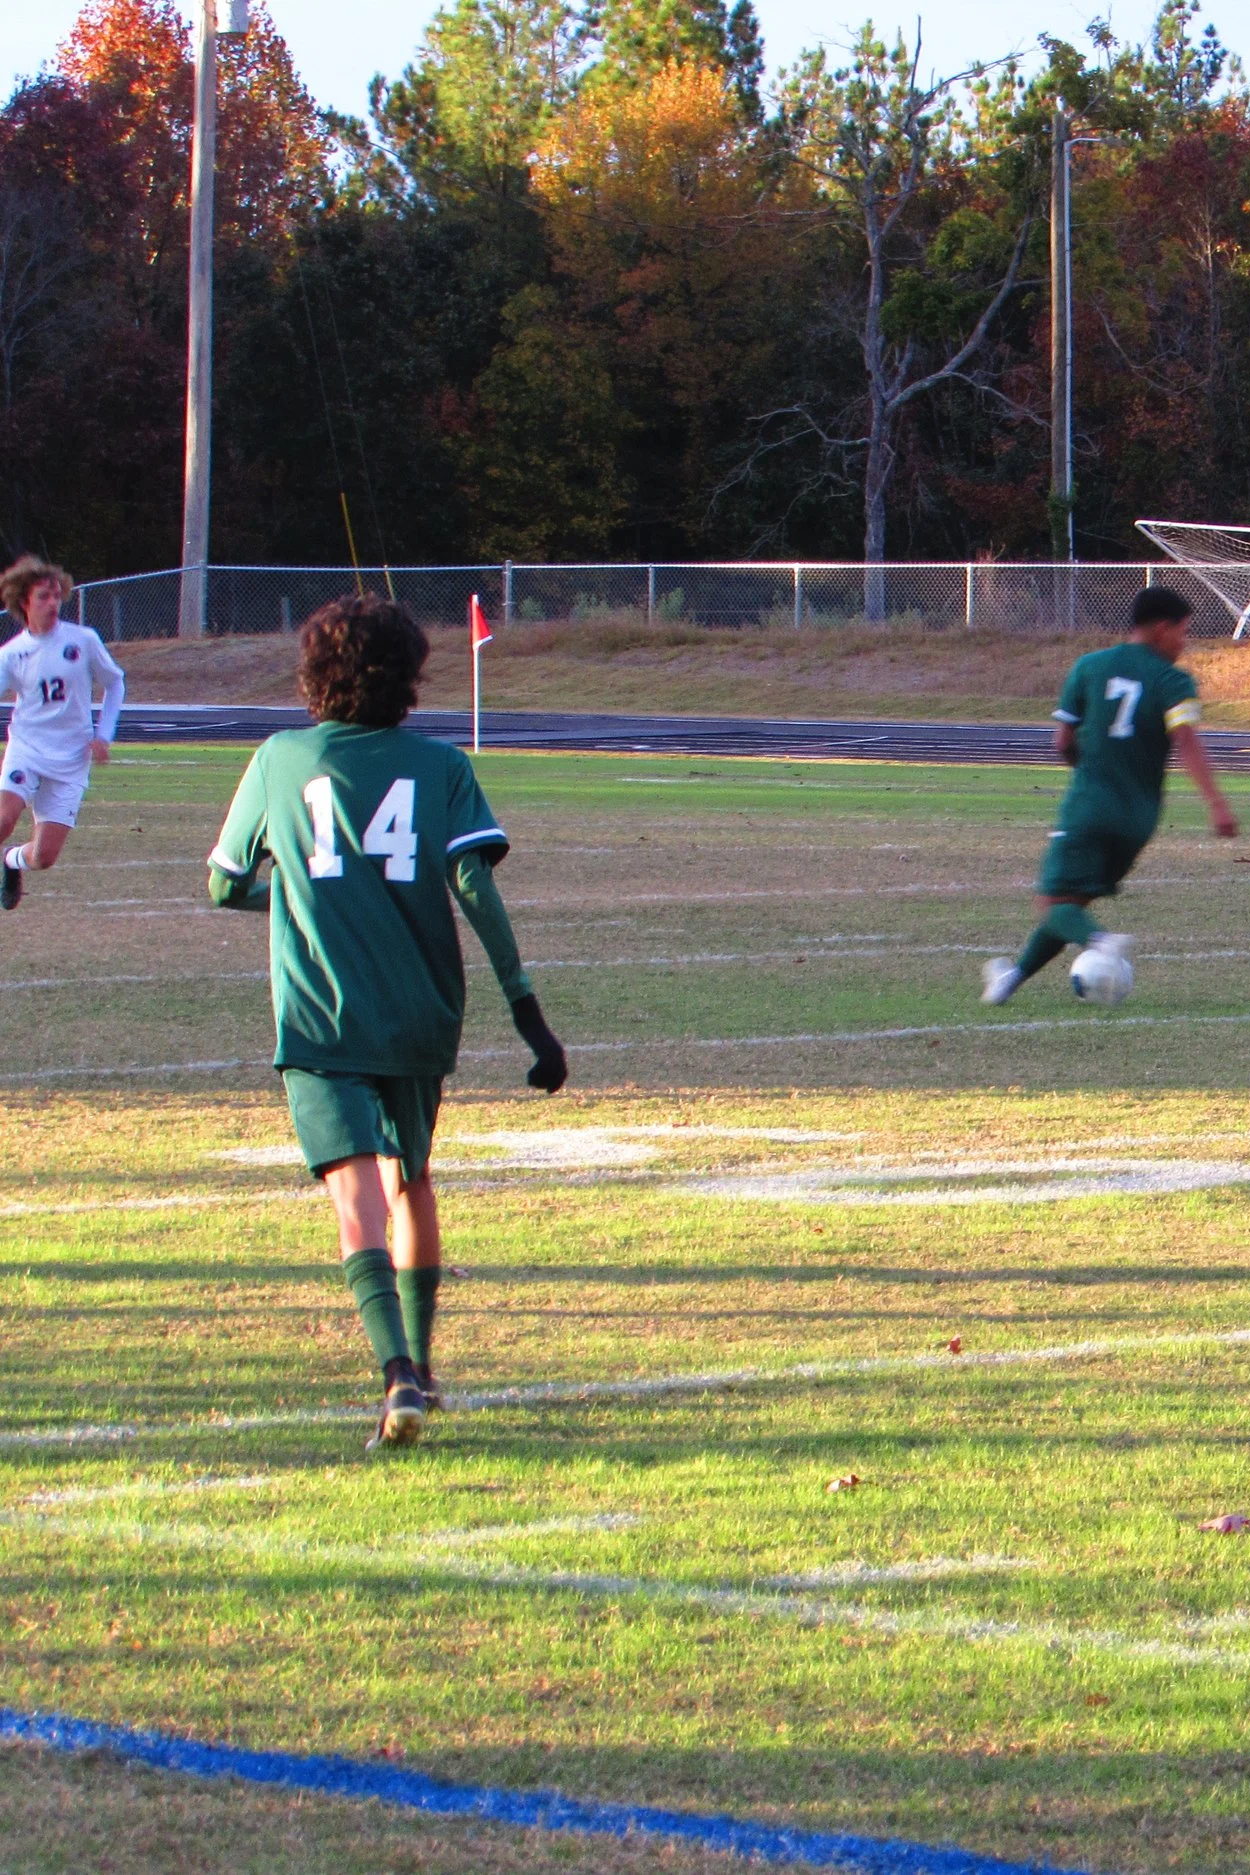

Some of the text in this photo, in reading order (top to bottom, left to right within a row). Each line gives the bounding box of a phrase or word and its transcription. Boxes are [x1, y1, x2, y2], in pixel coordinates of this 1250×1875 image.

[40, 678, 65, 703] 12
[1105, 676, 1142, 739] 7
[303, 776, 418, 882] 14
